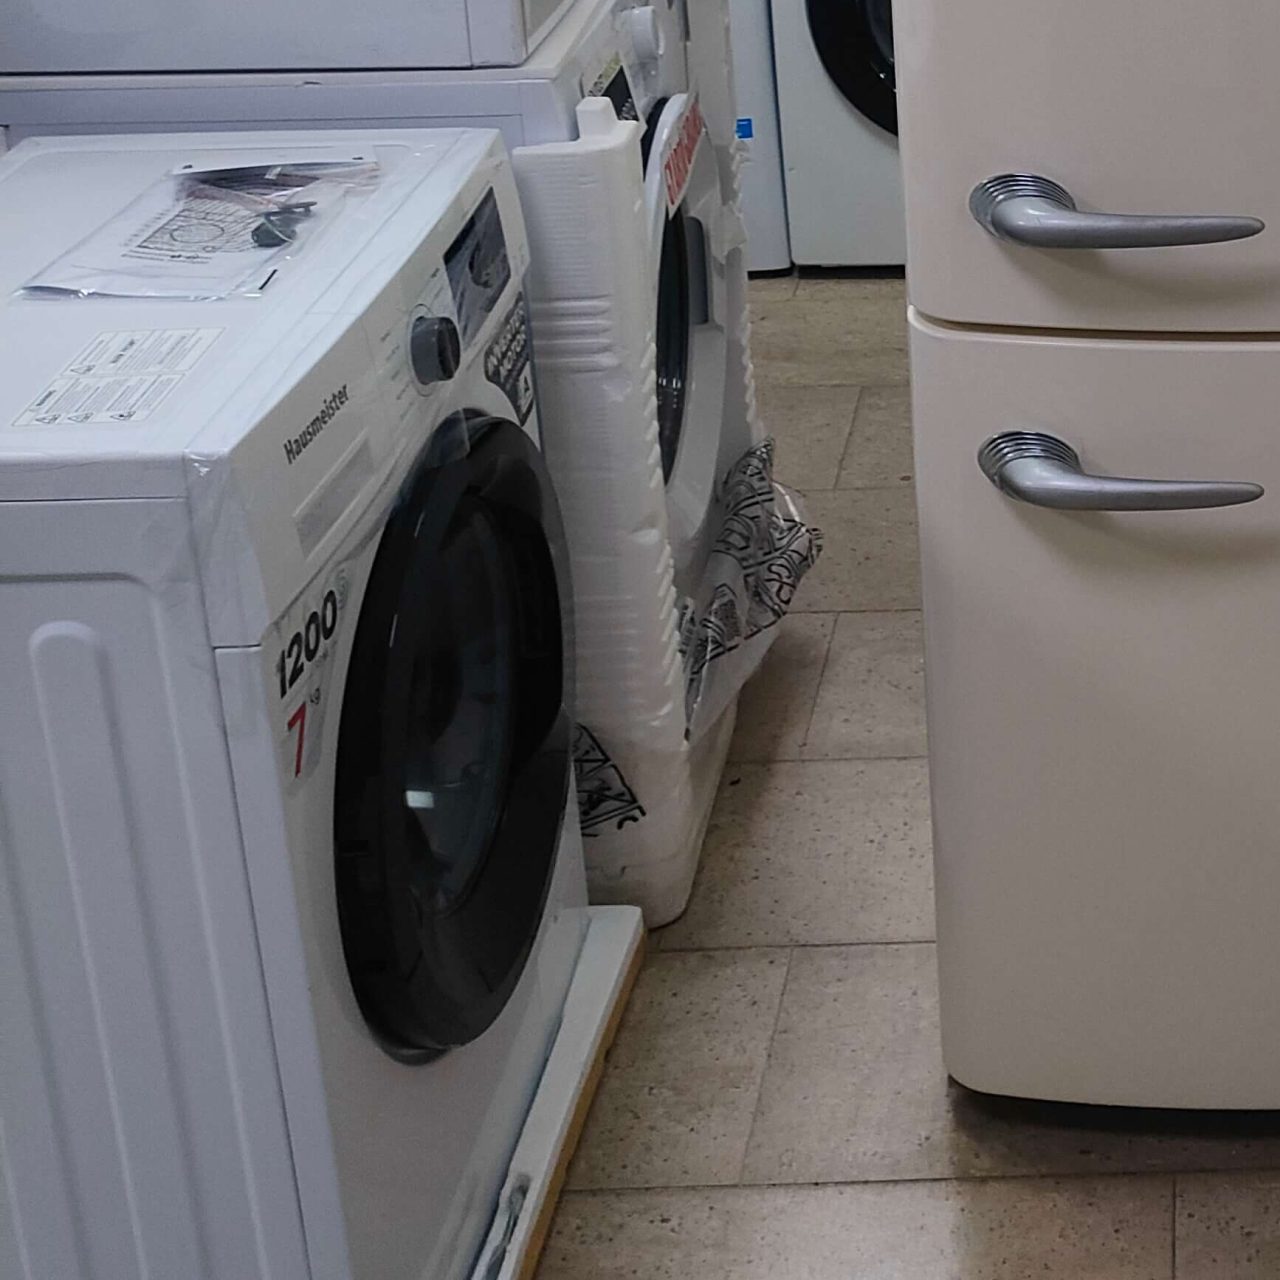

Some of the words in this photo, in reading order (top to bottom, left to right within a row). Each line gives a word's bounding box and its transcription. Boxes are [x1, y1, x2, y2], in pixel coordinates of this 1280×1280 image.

[283, 383, 349, 465] Hausmeister
[279, 589, 338, 700] 1200
[287, 700, 307, 779] 7
